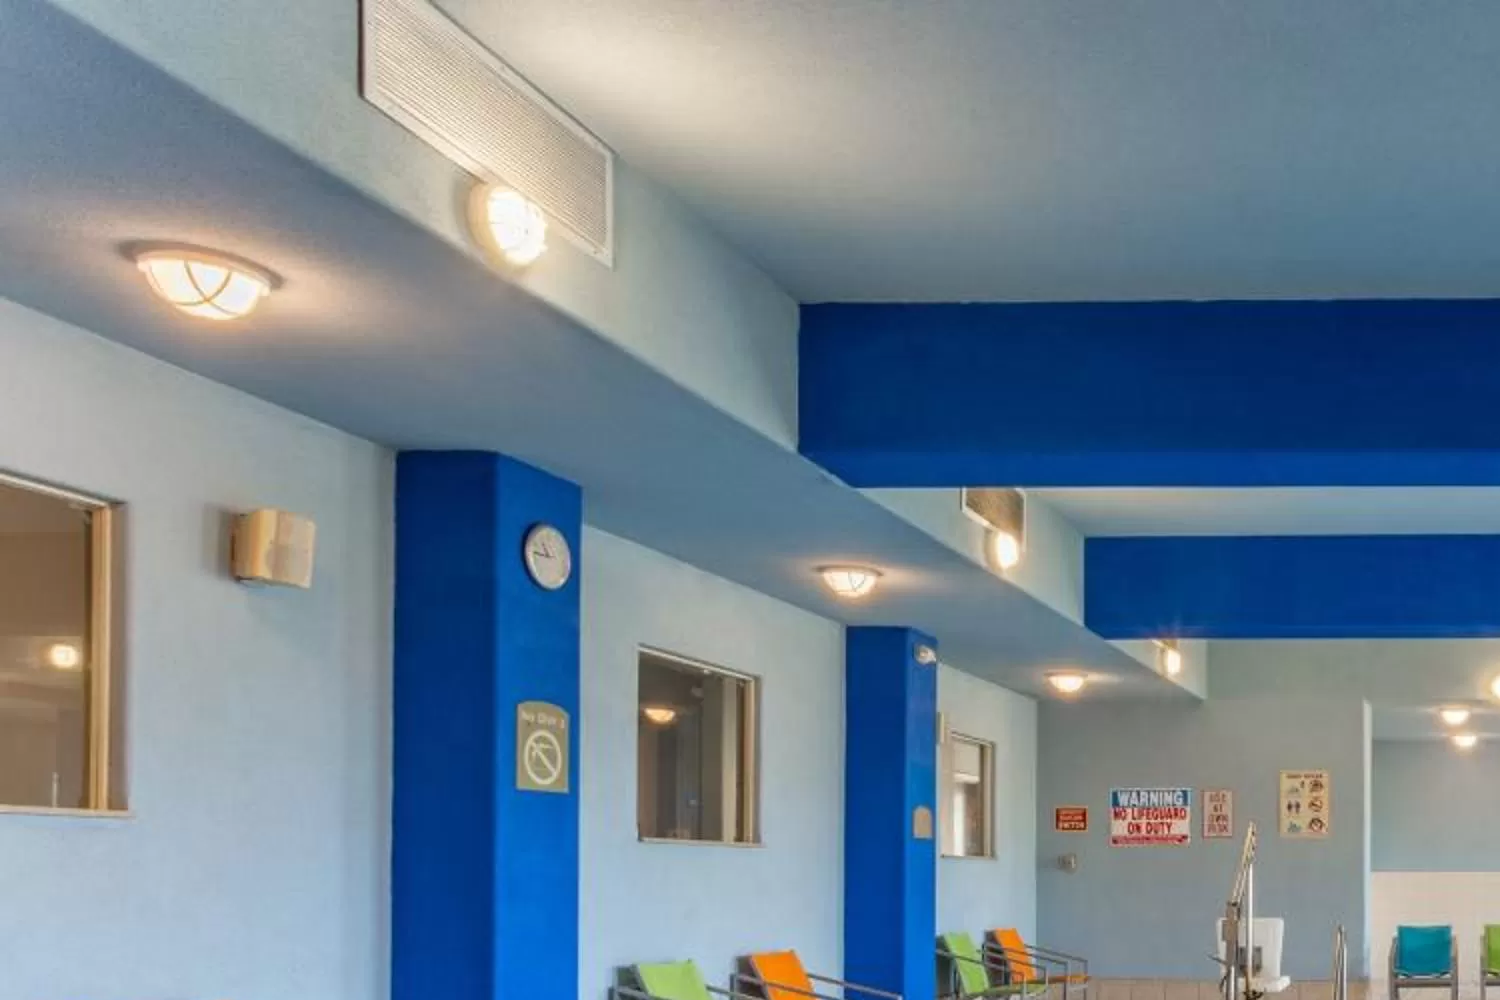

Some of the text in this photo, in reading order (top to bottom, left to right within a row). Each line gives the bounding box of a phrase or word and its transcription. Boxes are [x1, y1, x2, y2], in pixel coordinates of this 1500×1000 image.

[1118, 791, 1185, 807] WARNING
[1113, 808, 1187, 821] NO LIFEGUARD
[1127, 822, 1173, 834] ON DUTY
